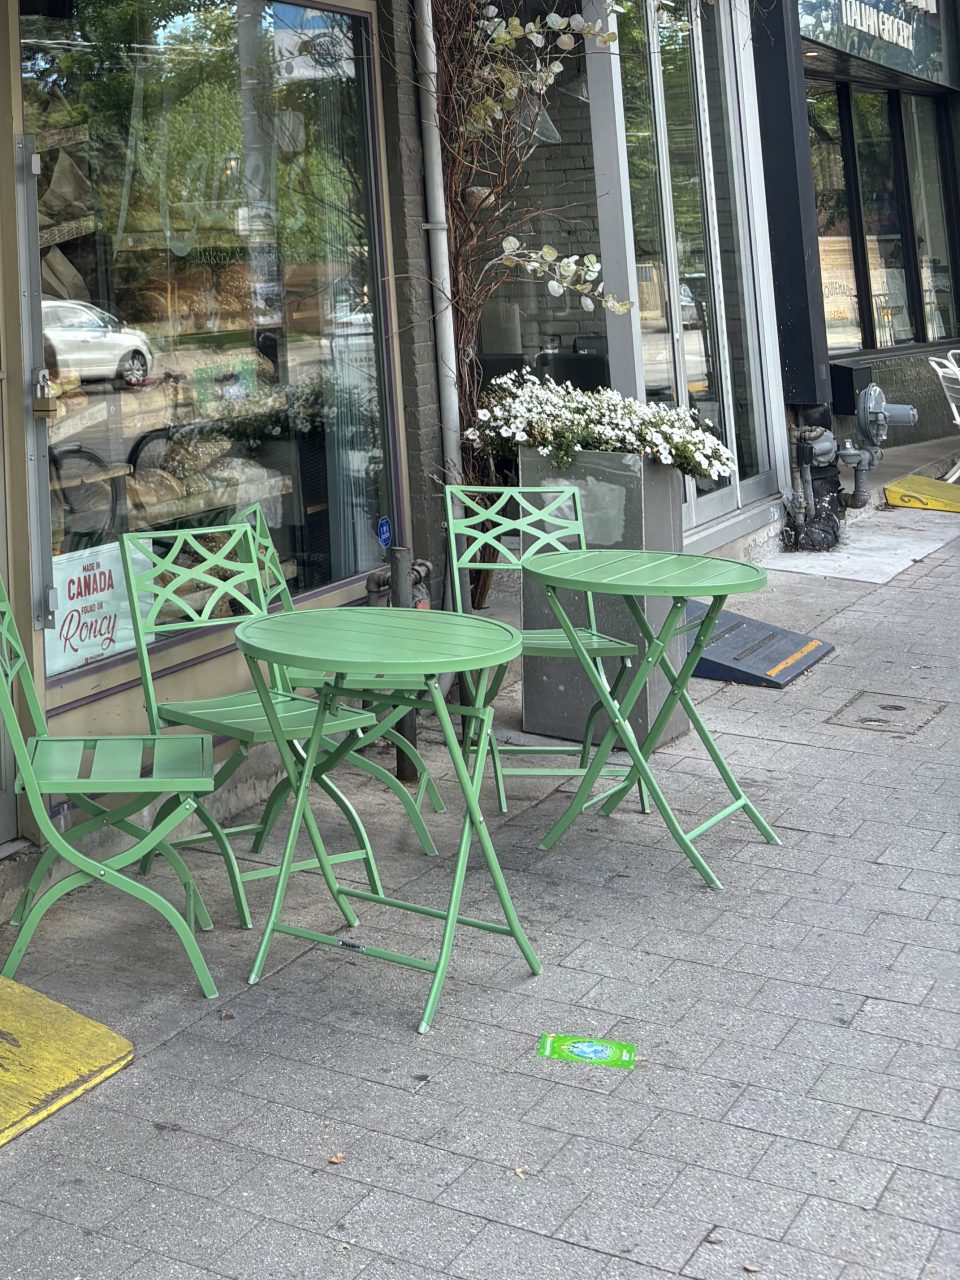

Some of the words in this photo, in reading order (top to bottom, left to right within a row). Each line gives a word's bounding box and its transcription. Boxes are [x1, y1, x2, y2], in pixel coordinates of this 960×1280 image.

[83, 563, 95, 573] MADE
[67, 569, 115, 600] CANADA
[81, 603, 96, 615] FOUND
[59, 609, 117, 653] Roncy
